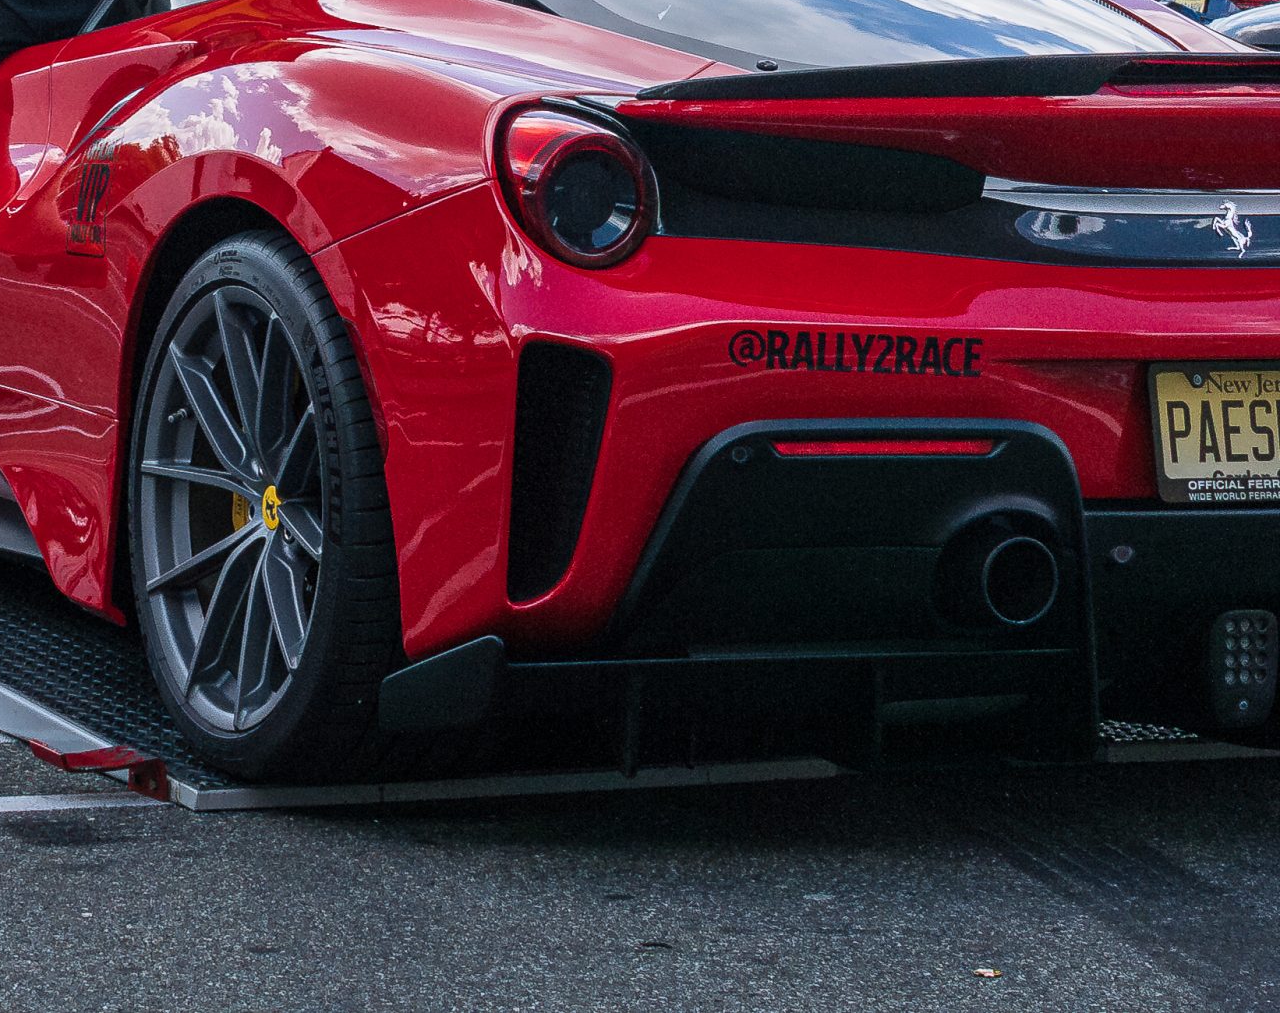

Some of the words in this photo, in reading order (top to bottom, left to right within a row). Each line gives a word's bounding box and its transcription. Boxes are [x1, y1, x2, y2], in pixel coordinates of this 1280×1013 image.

[76, 163, 110, 222] VIP
[728, 329, 984, 377] @RALLY2RACE
[1206, 373, 1251, 394] New
[1166, 400, 1280, 463] PAES
[1188, 479, 1245, 490] OFFICIAL
[1189, 493, 1212, 501] WIDE
[1215, 492, 1247, 500] WORLD
[1249, 491, 1280, 500] FERRA
